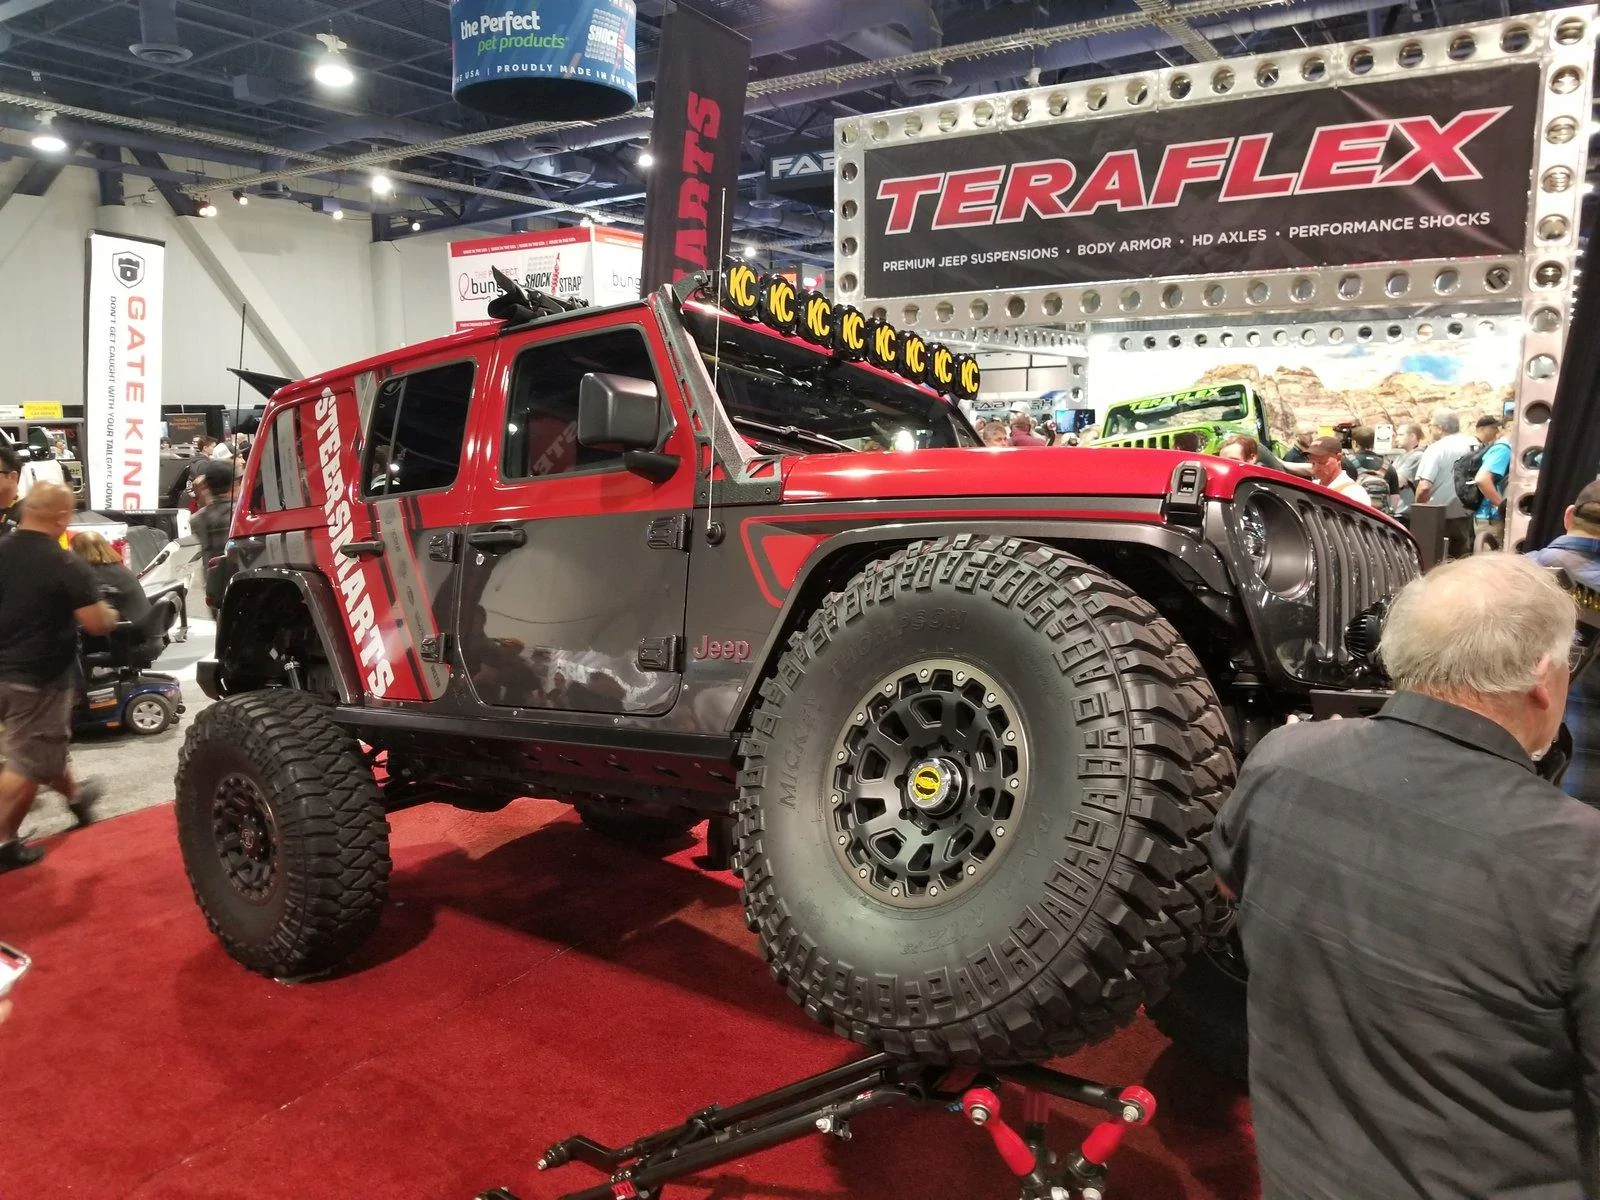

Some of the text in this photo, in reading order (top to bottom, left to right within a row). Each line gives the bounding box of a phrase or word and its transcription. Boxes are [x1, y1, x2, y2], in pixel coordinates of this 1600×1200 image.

[461, 11, 541, 40] the Perfect
[477, 34, 497, 56] pet
[499, 33, 565, 52] products
[465, 69, 481, 79] USA
[496, 64, 553, 74] PROUDLY
[560, 65, 591, 77] MADE
[596, 71, 608, 80] IN
[611, 74, 626, 87] THE
[877, 105, 1513, 236] TERAFLEX
[882, 212, 1491, 272] PREMIUM JEEP SUSPENSIONS BODY ARMOR HD AXLES PERFORMANCE SHOCKS
[471, 277, 518, 297] bung
[525, 272, 552, 288] SHOCK
[559, 276, 582, 292] STRAP
[729, 265, 756, 307] KC
[769, 282, 795, 323] KC
[807, 297, 831, 337] KC
[842, 311, 864, 350] KC
[875, 325, 896, 362] KC
[905, 337, 925, 373] KC
[934, 348, 952, 384] KC
[961, 358, 978, 393] KC
[122, 295, 146, 510] GATE KING
[1128, 387, 1223, 411] TERAFLEX
[106, 412, 114, 437] YOUR
[105, 439, 114, 479] TAILGATE
[105, 482, 113, 510] DOWN
[314, 386, 395, 698] STEERSMARTS
[692, 634, 751, 664] Jeep
